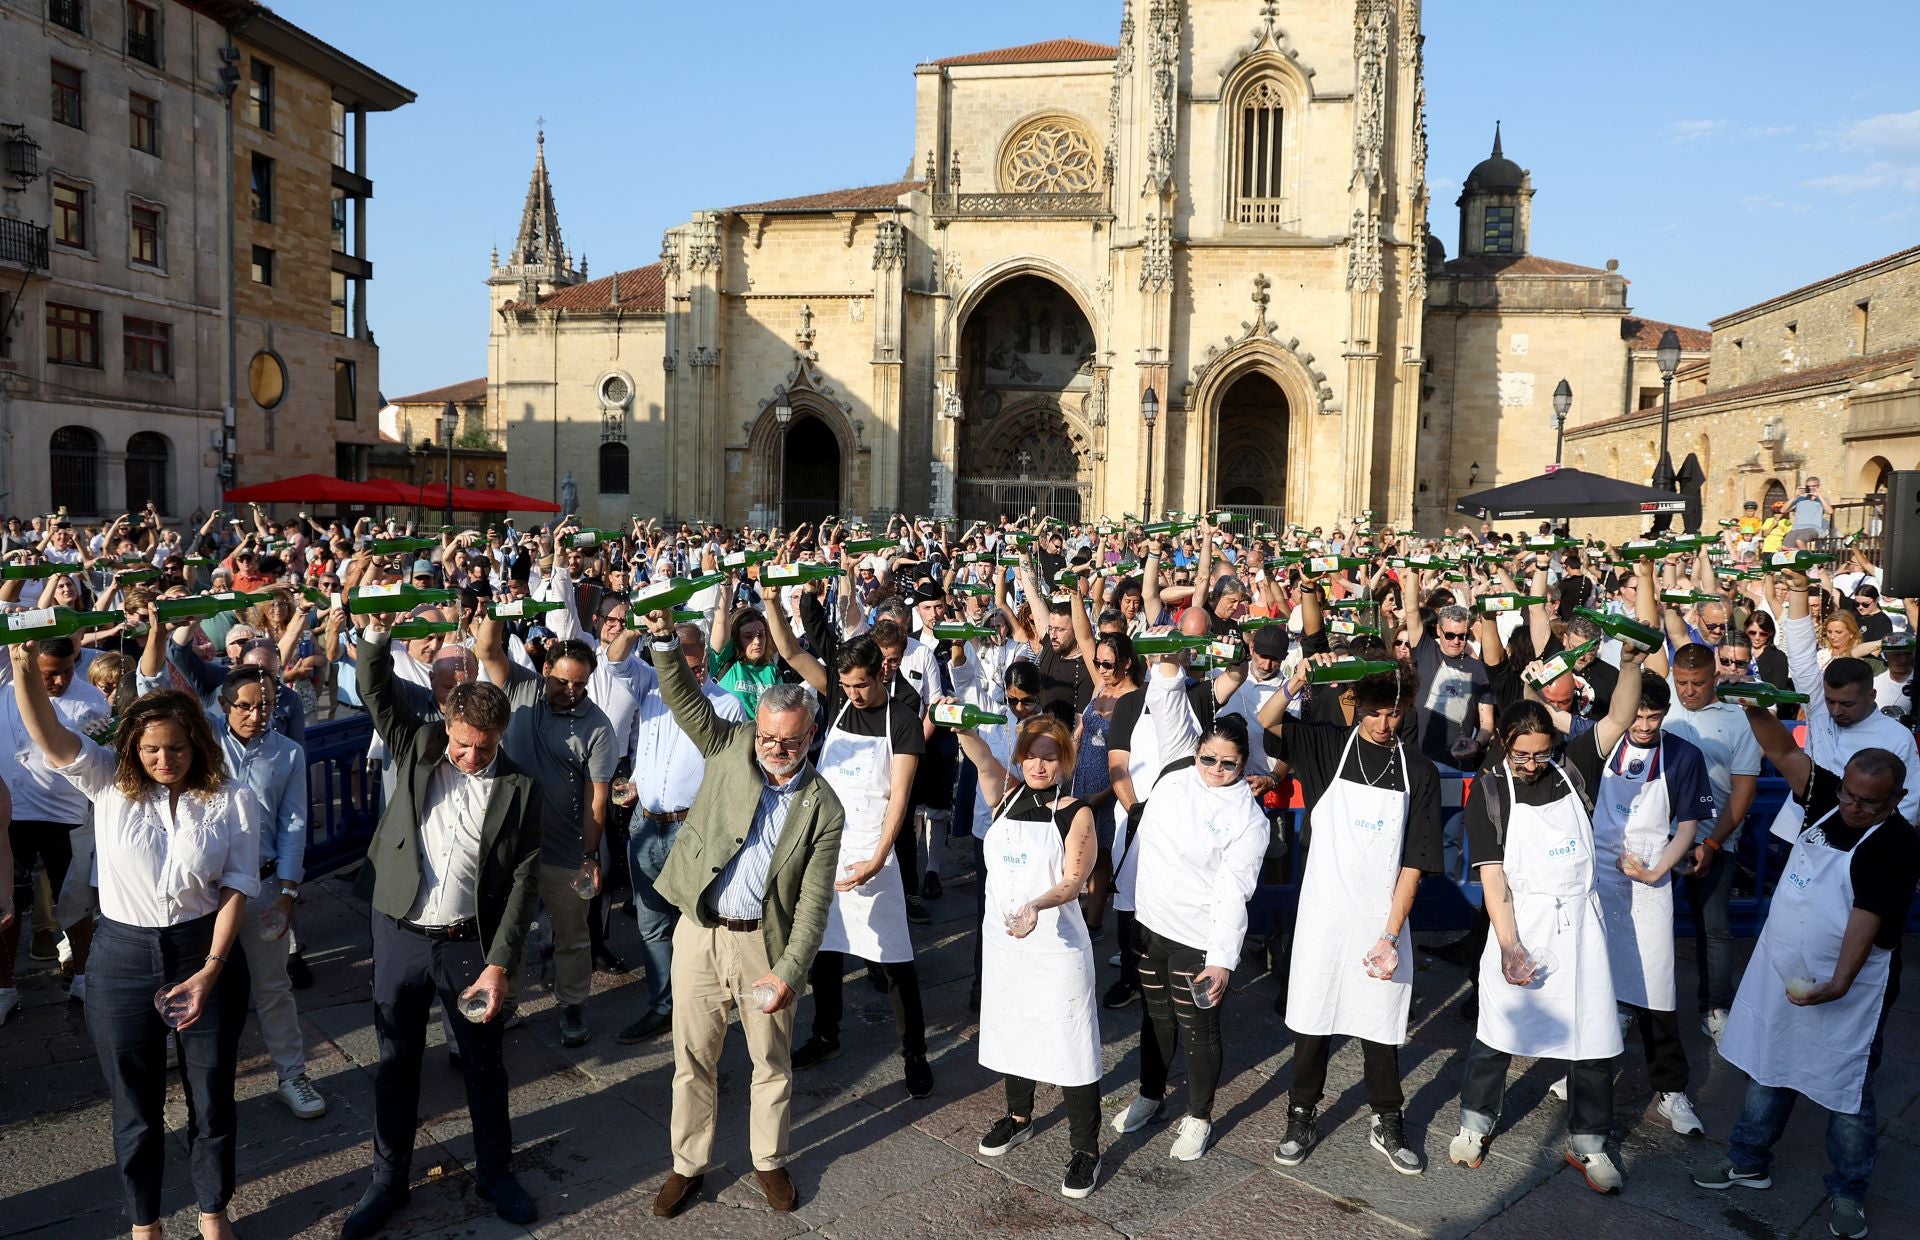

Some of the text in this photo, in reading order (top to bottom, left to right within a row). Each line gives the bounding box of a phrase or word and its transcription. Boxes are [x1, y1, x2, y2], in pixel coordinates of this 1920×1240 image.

[1355, 819, 1376, 831] otea
[1549, 846, 1570, 856] otea
[1003, 855, 1020, 864] otea
